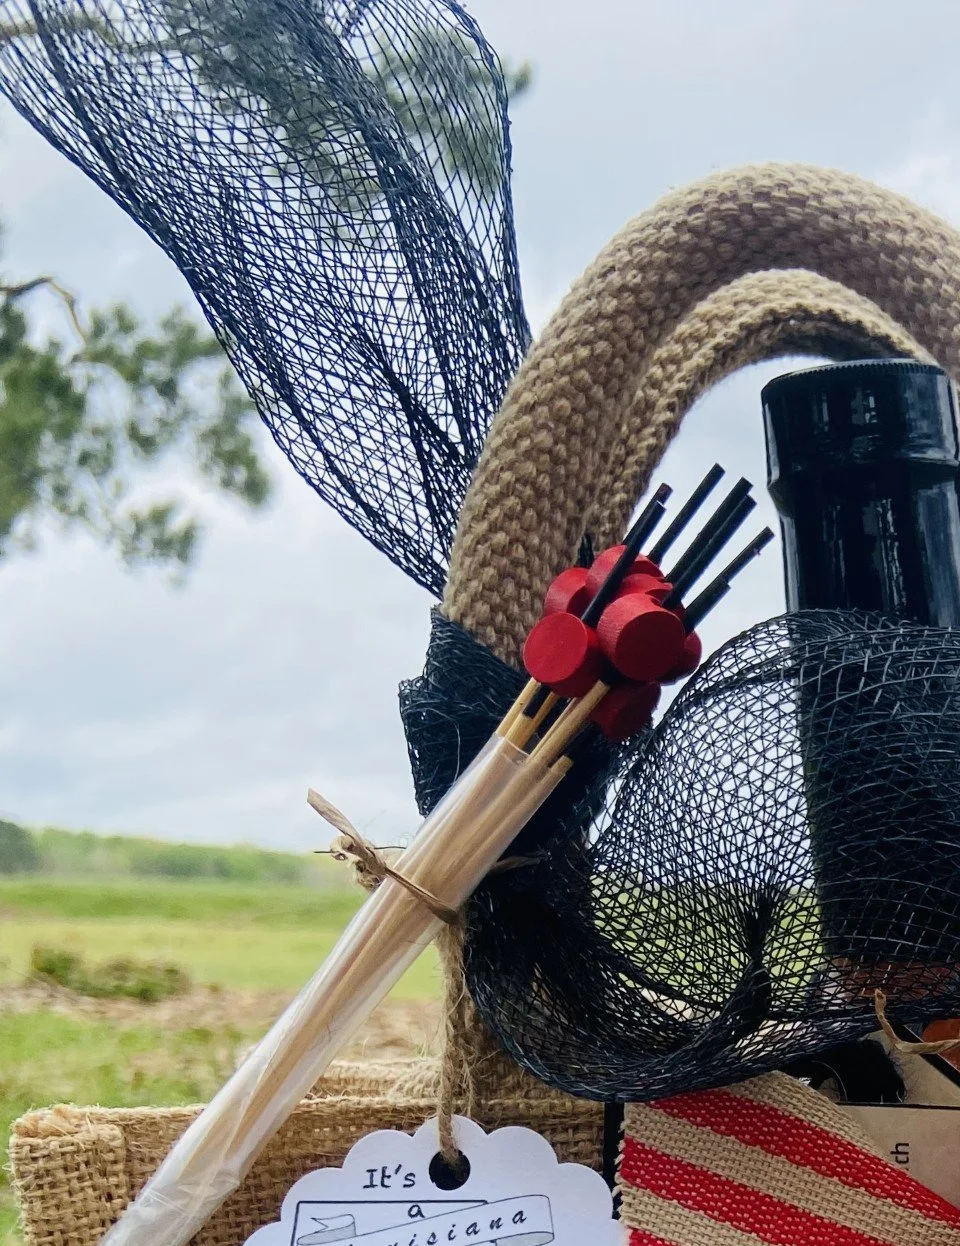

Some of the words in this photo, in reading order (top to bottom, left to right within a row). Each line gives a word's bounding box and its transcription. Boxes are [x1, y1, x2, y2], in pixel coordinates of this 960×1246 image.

[890, 1143, 910, 1171] ch
[363, 1165, 416, 1189] It's
[407, 1204, 425, 1218] a
